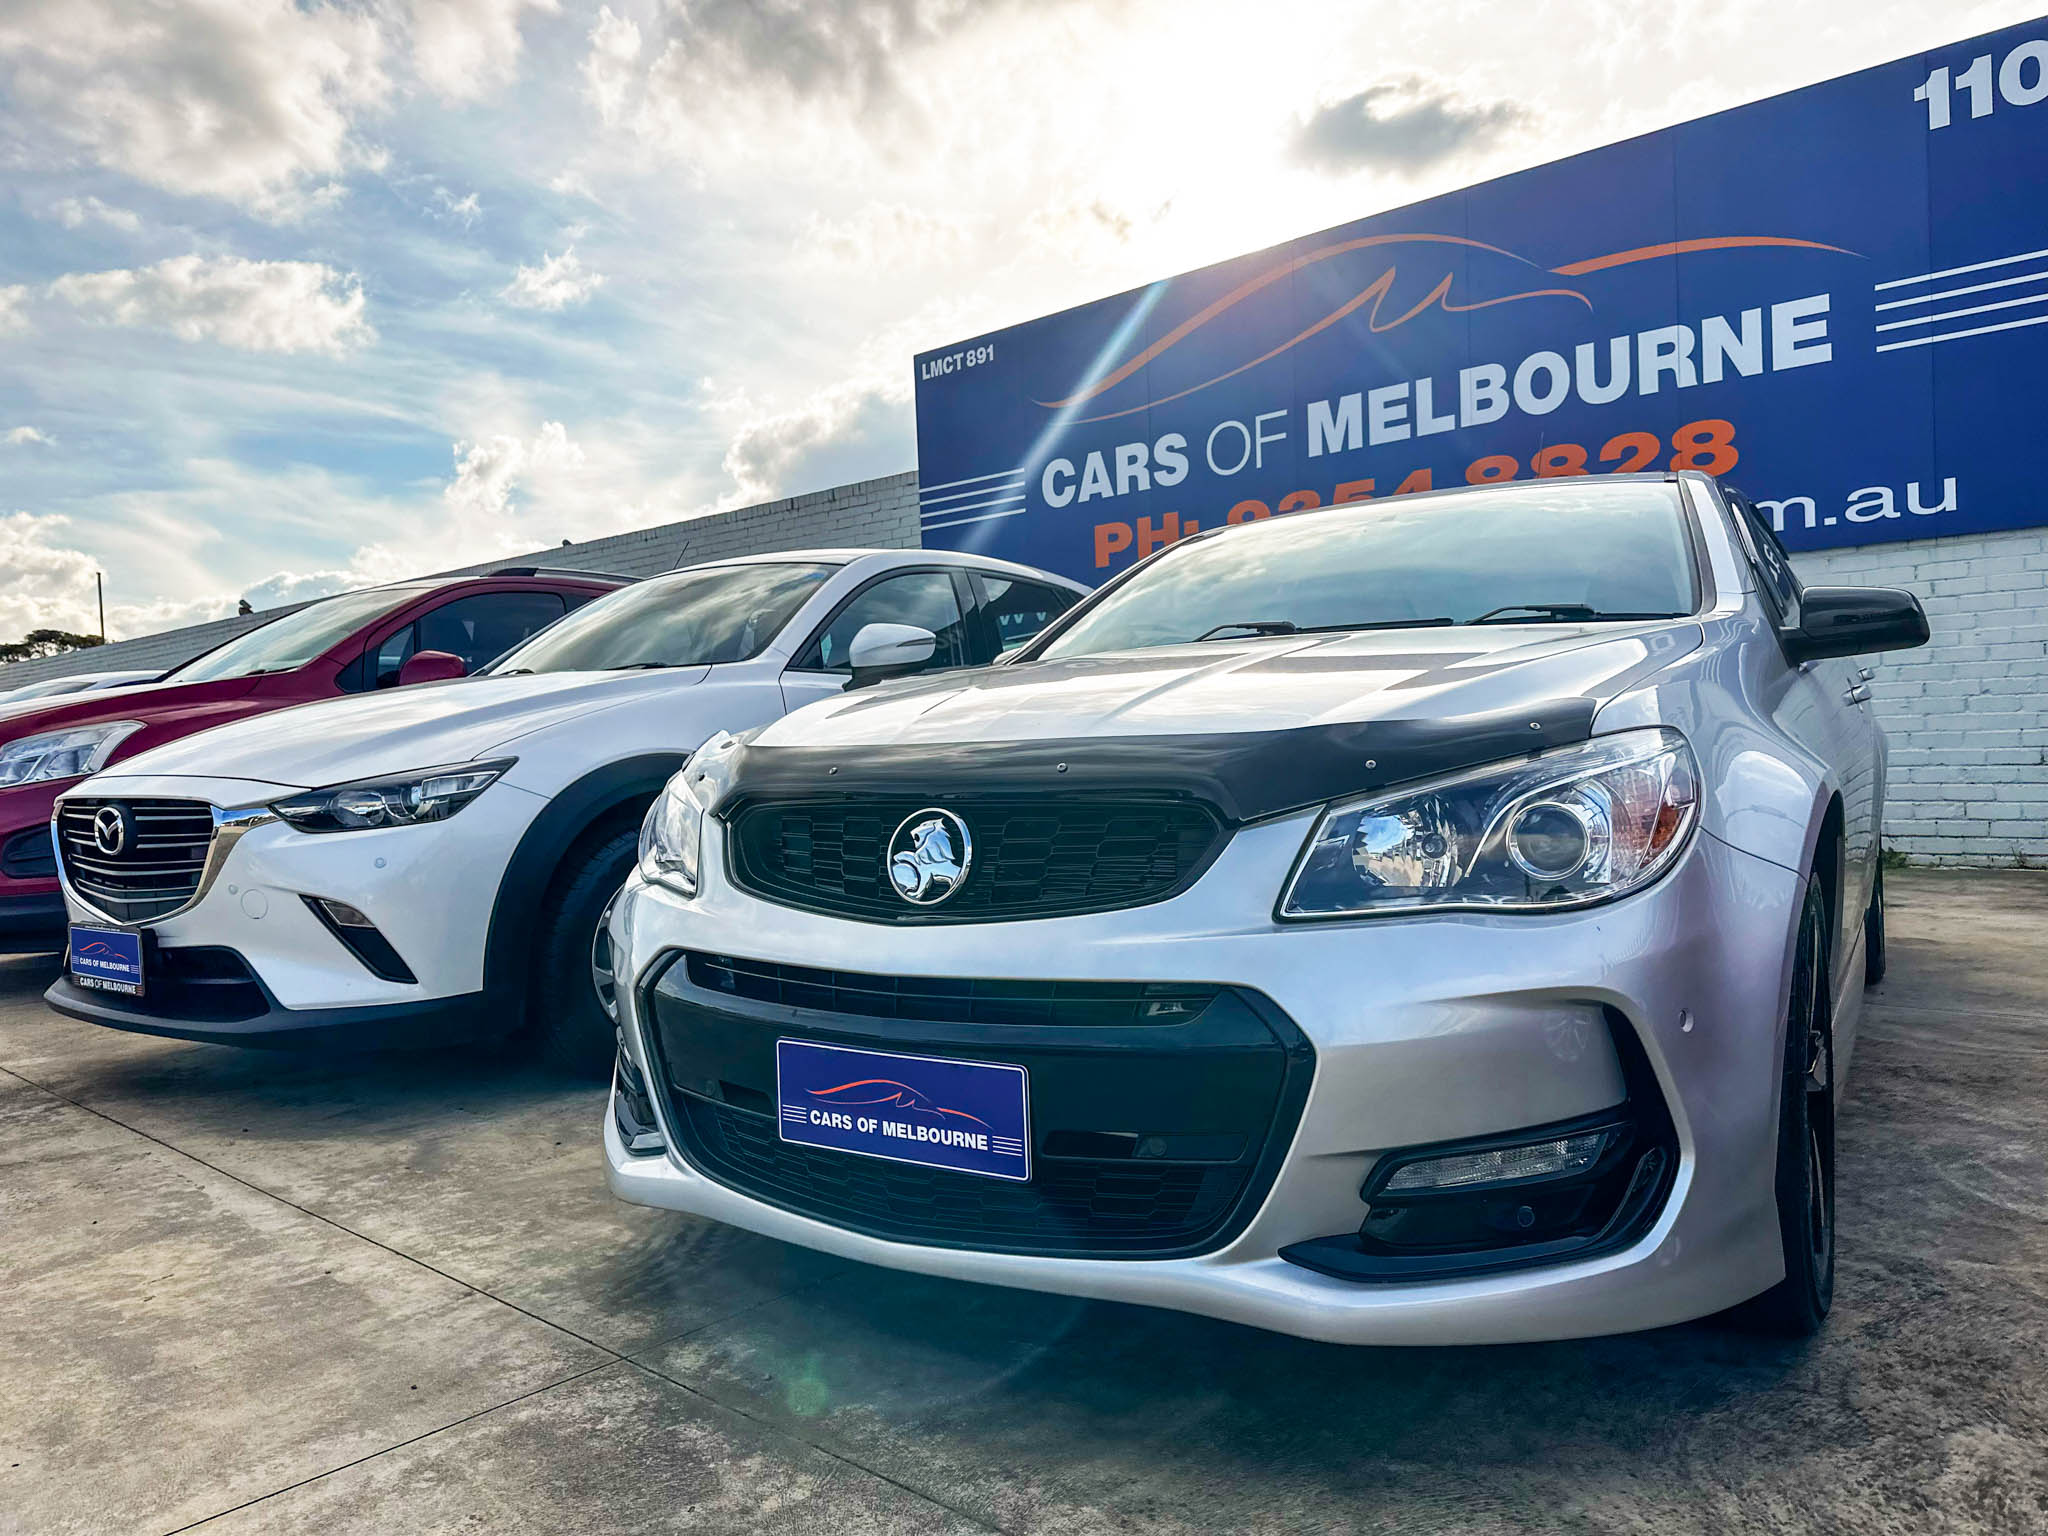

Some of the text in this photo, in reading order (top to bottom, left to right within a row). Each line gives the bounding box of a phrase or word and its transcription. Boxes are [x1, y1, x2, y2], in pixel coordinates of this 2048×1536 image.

[1913, 40, 2048, 130] 110
[922, 344, 994, 380] LMCT 891
[1042, 433, 1189, 508] CARS
[1206, 409, 1288, 476] OF
[1307, 293, 1833, 458] MELBOURNE
[80, 957, 92, 967] CARS
[100, 961, 130, 973] MELBOURNE
[80, 977, 136, 994] CARS OF MELBOURNE
[810, 1110, 988, 1151] CARS OF MELBOURNE
